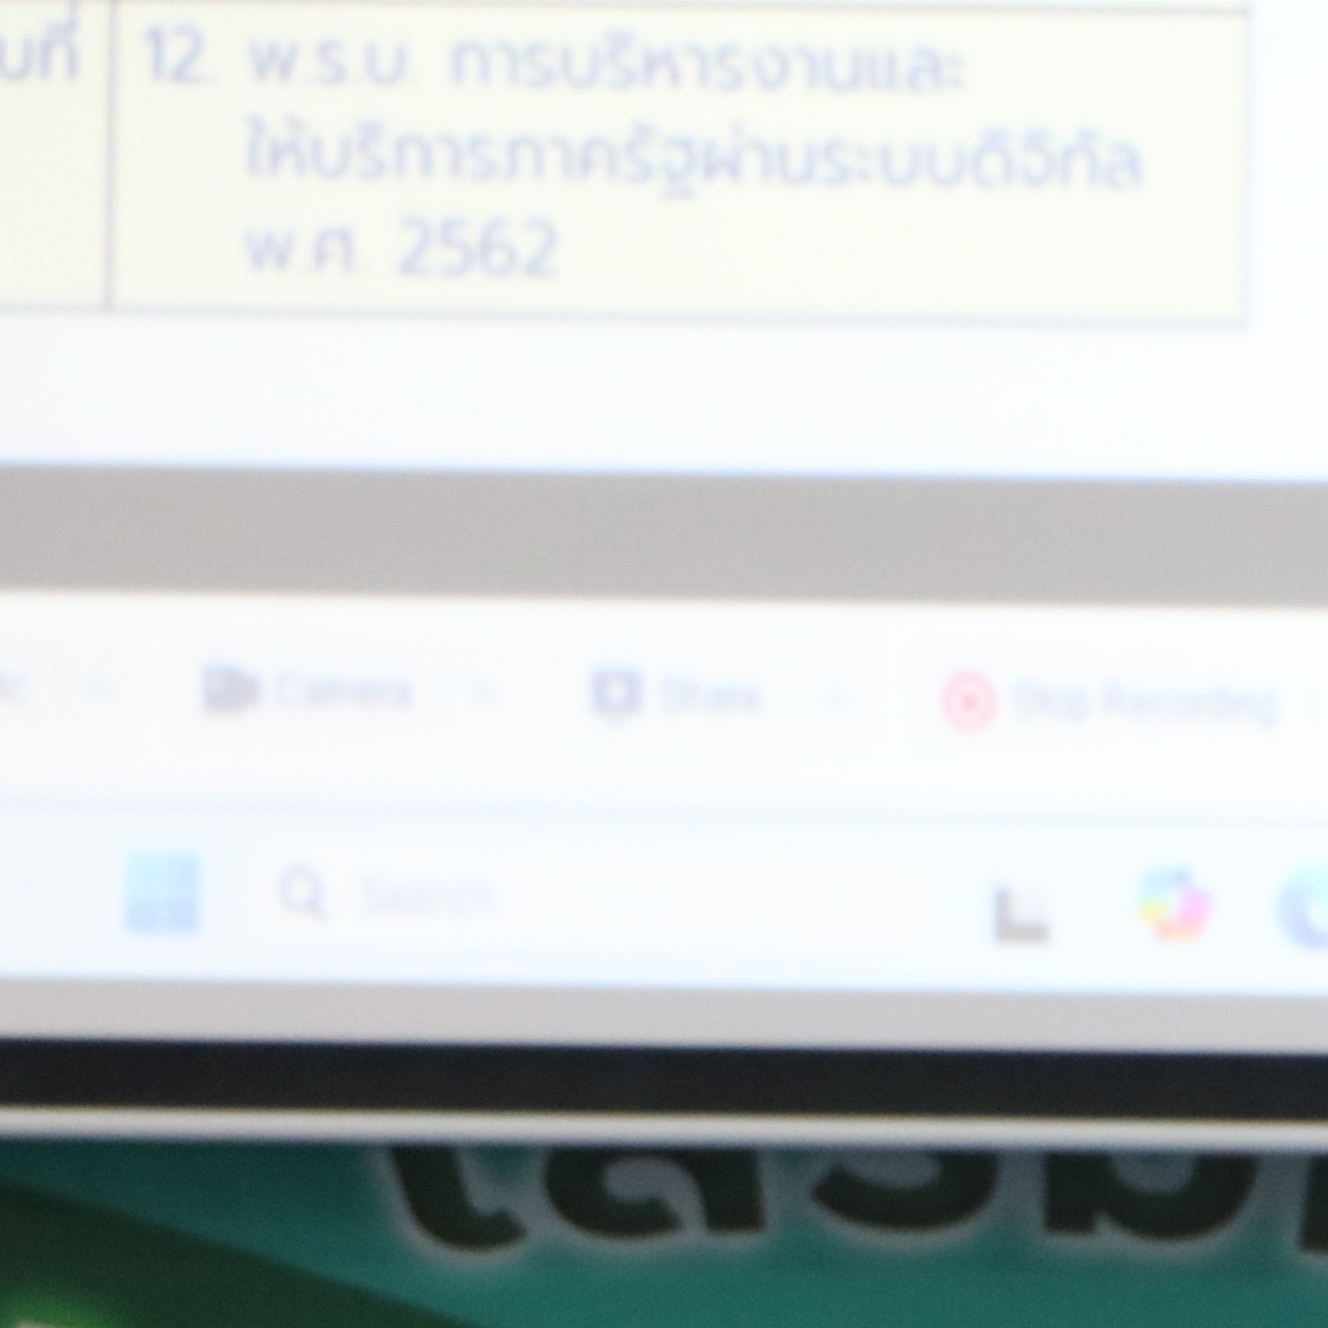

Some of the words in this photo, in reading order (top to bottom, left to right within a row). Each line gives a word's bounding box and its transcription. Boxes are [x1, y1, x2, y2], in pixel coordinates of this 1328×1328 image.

[450, 29, 967, 94] การบริหารงานและ
[398, 215, 560, 277] 2562
